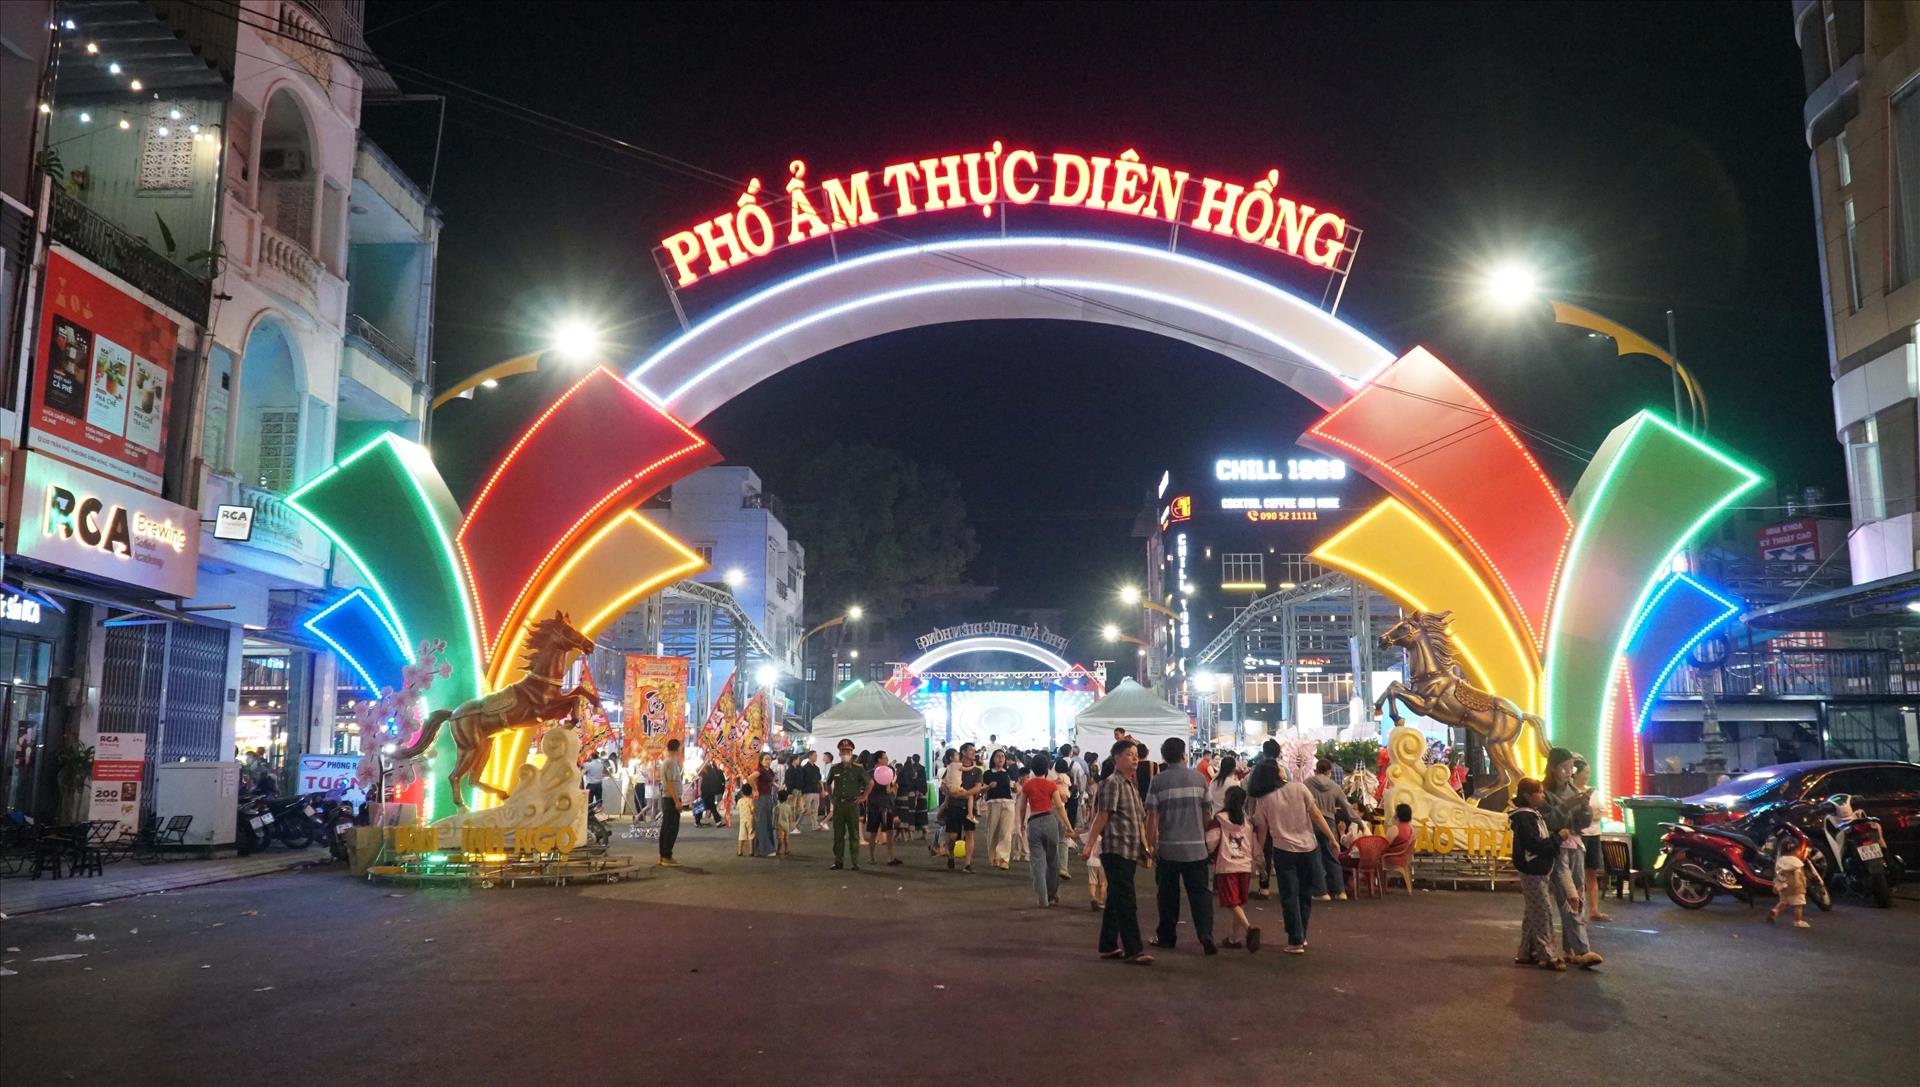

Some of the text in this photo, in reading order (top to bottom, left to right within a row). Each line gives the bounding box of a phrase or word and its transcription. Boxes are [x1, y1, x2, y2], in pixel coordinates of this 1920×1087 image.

[662, 140, 1346, 288] PHỐ ẨM THỰC DIÊN HỒNG
[1215, 459, 1282, 480] CHILL
[43, 485, 132, 558] RCA
[222, 511, 248, 521] RCA
[1260, 511, 1318, 520] 090 52 11111
[134, 512, 187, 553] Brewing
[100, 735, 119, 743] RCA
[95, 790, 118, 798] 200
